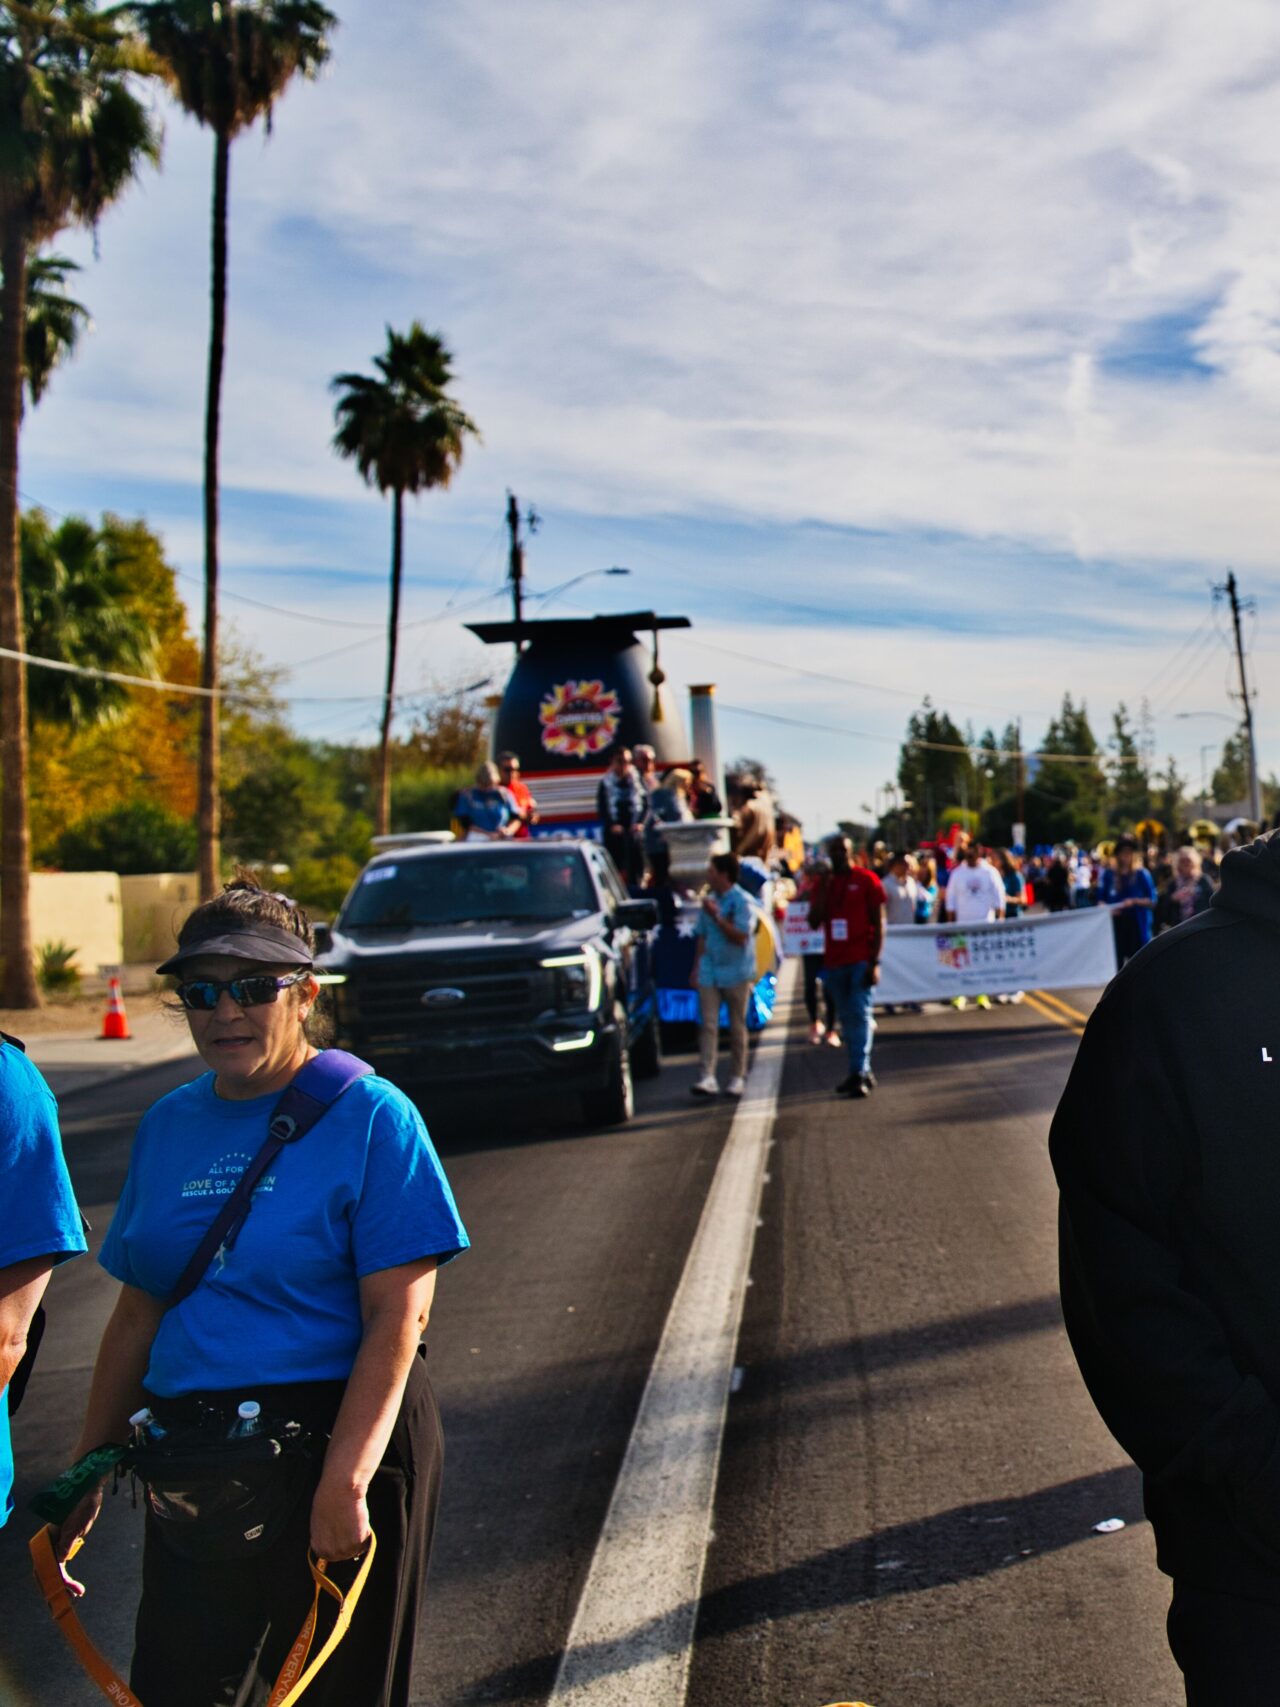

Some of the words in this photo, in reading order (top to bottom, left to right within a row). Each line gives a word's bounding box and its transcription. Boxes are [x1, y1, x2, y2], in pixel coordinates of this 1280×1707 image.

[972, 938, 1035, 951] SCIENCE
[208, 1166, 224, 1174] ALL
[225, 1166, 244, 1174] FOR
[183, 1179, 212, 1191] LOVE
[214, 1180, 228, 1188] OF
[230, 1179, 237, 1187] A
[182, 1189, 207, 1197] RESCUE
[106, 1681, 137, 1707] ONE
